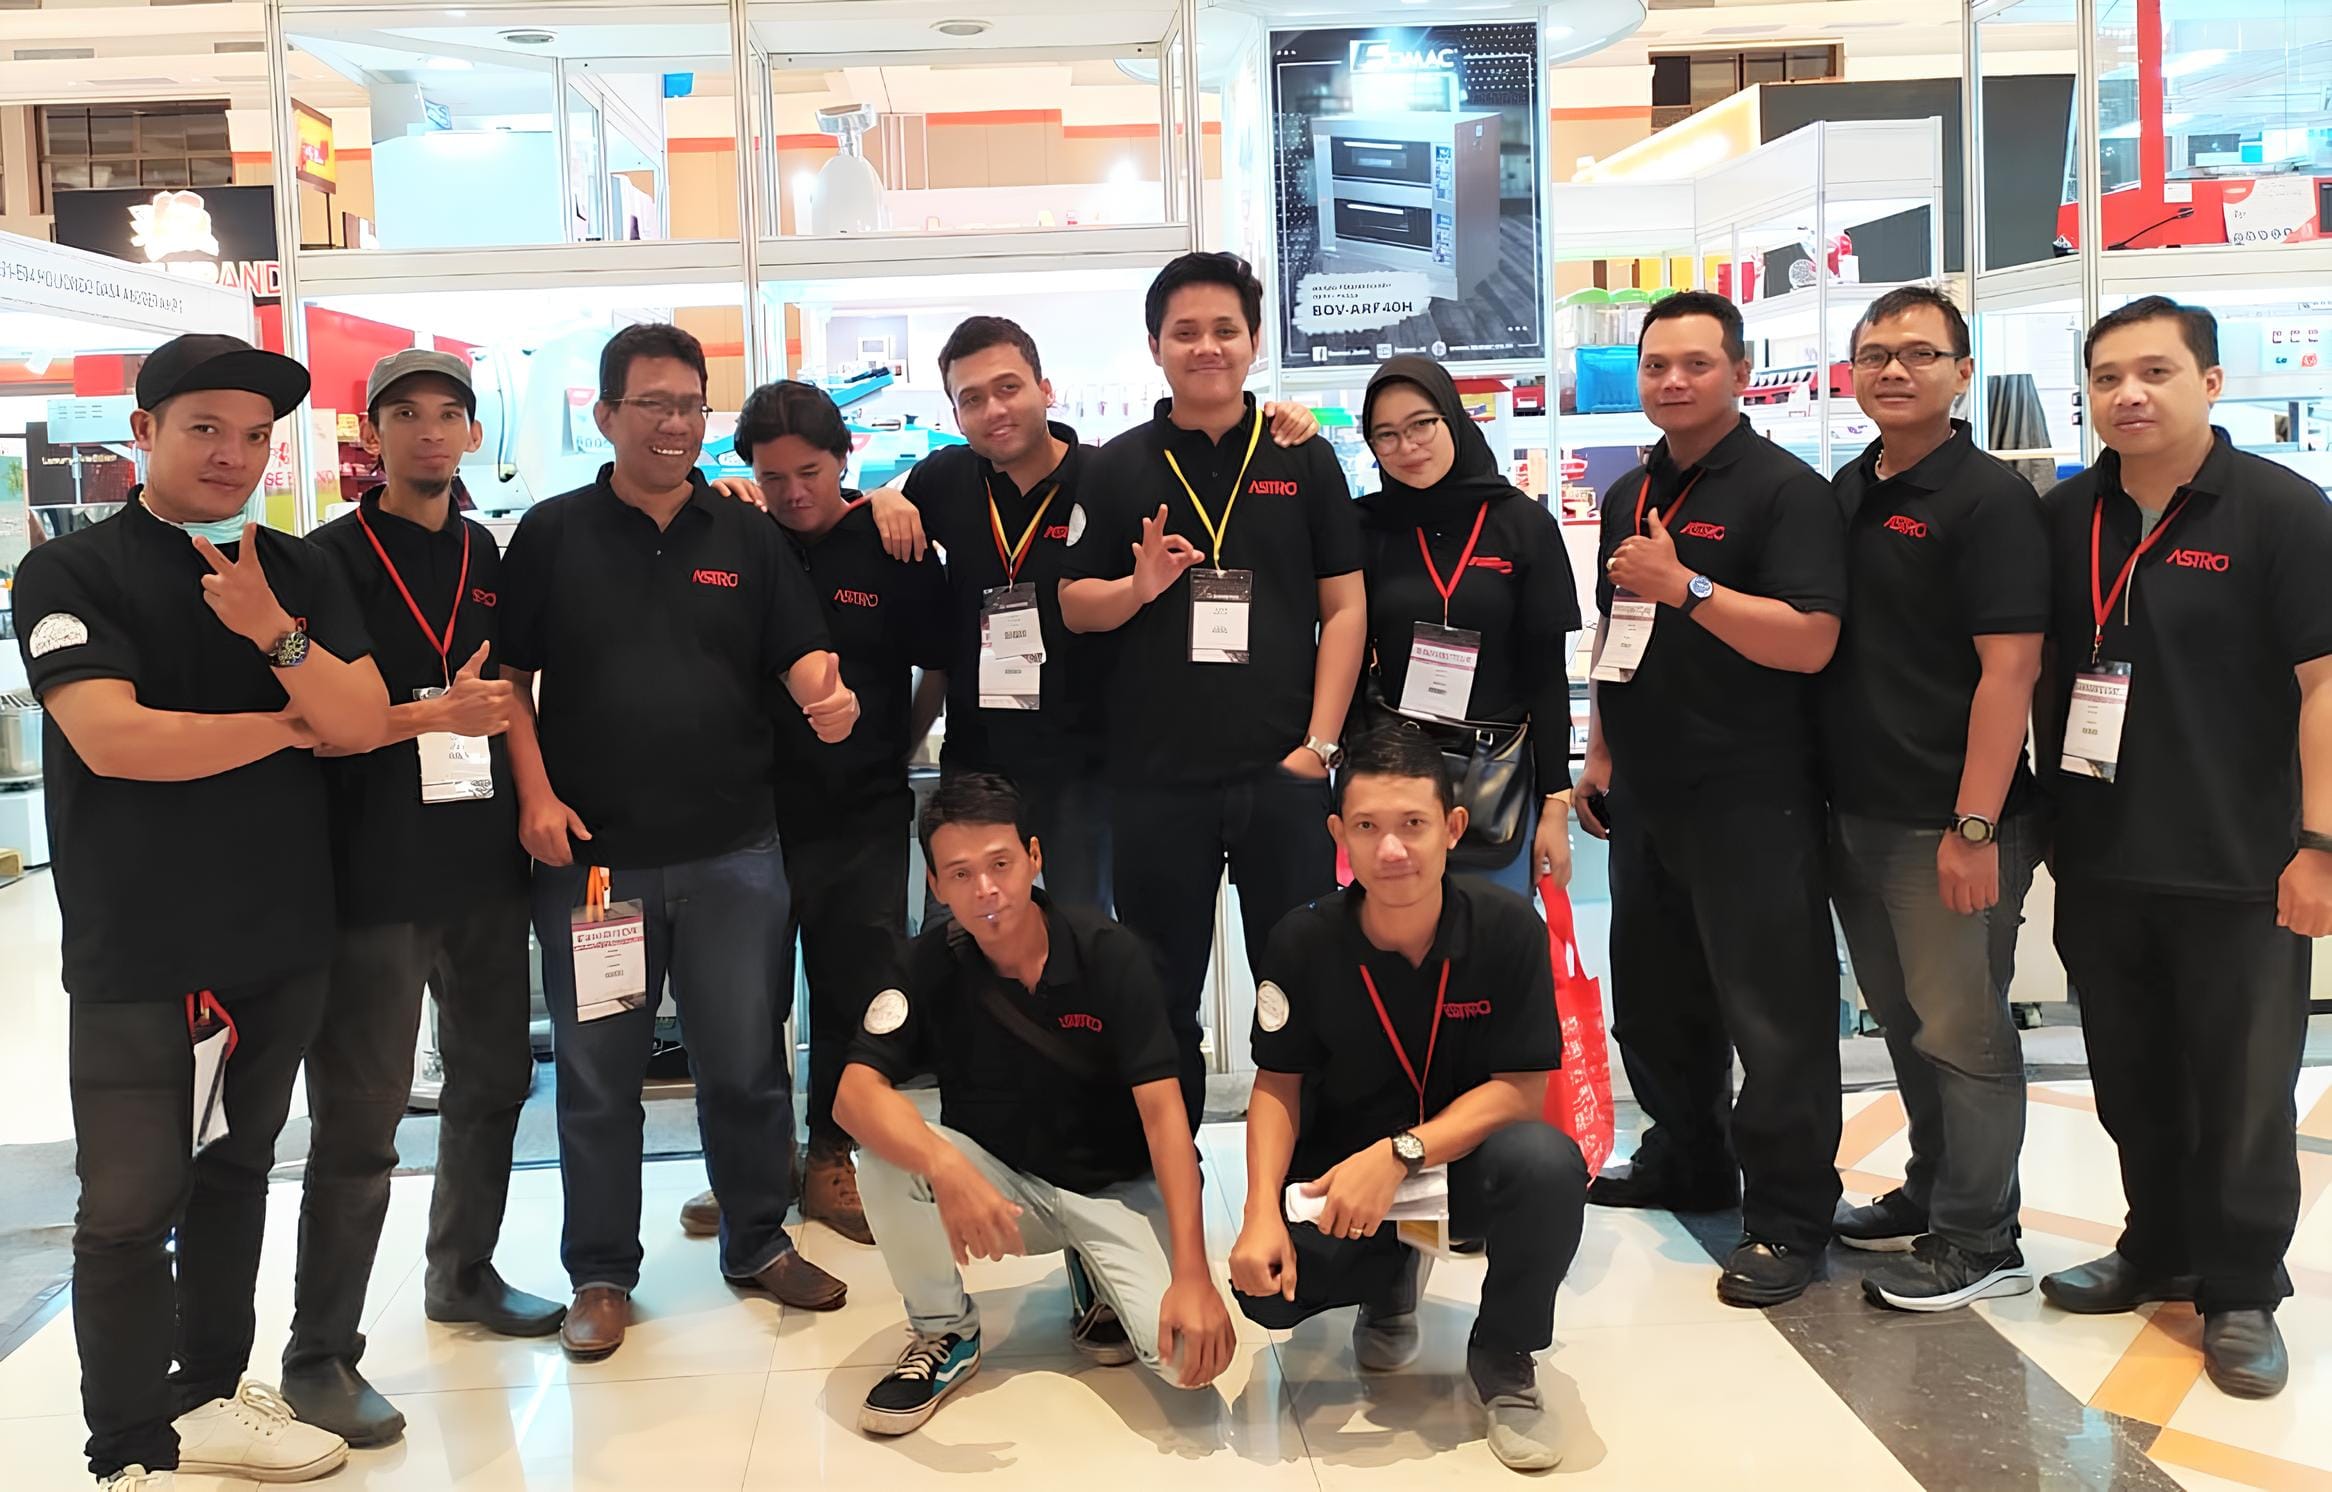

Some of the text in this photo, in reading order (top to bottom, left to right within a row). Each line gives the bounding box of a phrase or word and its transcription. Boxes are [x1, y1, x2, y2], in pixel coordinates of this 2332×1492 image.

[1248, 479, 1298, 497] ASTRO
[2166, 549, 2230, 572] ASTRO
[692, 569, 739, 588] ASTRO
